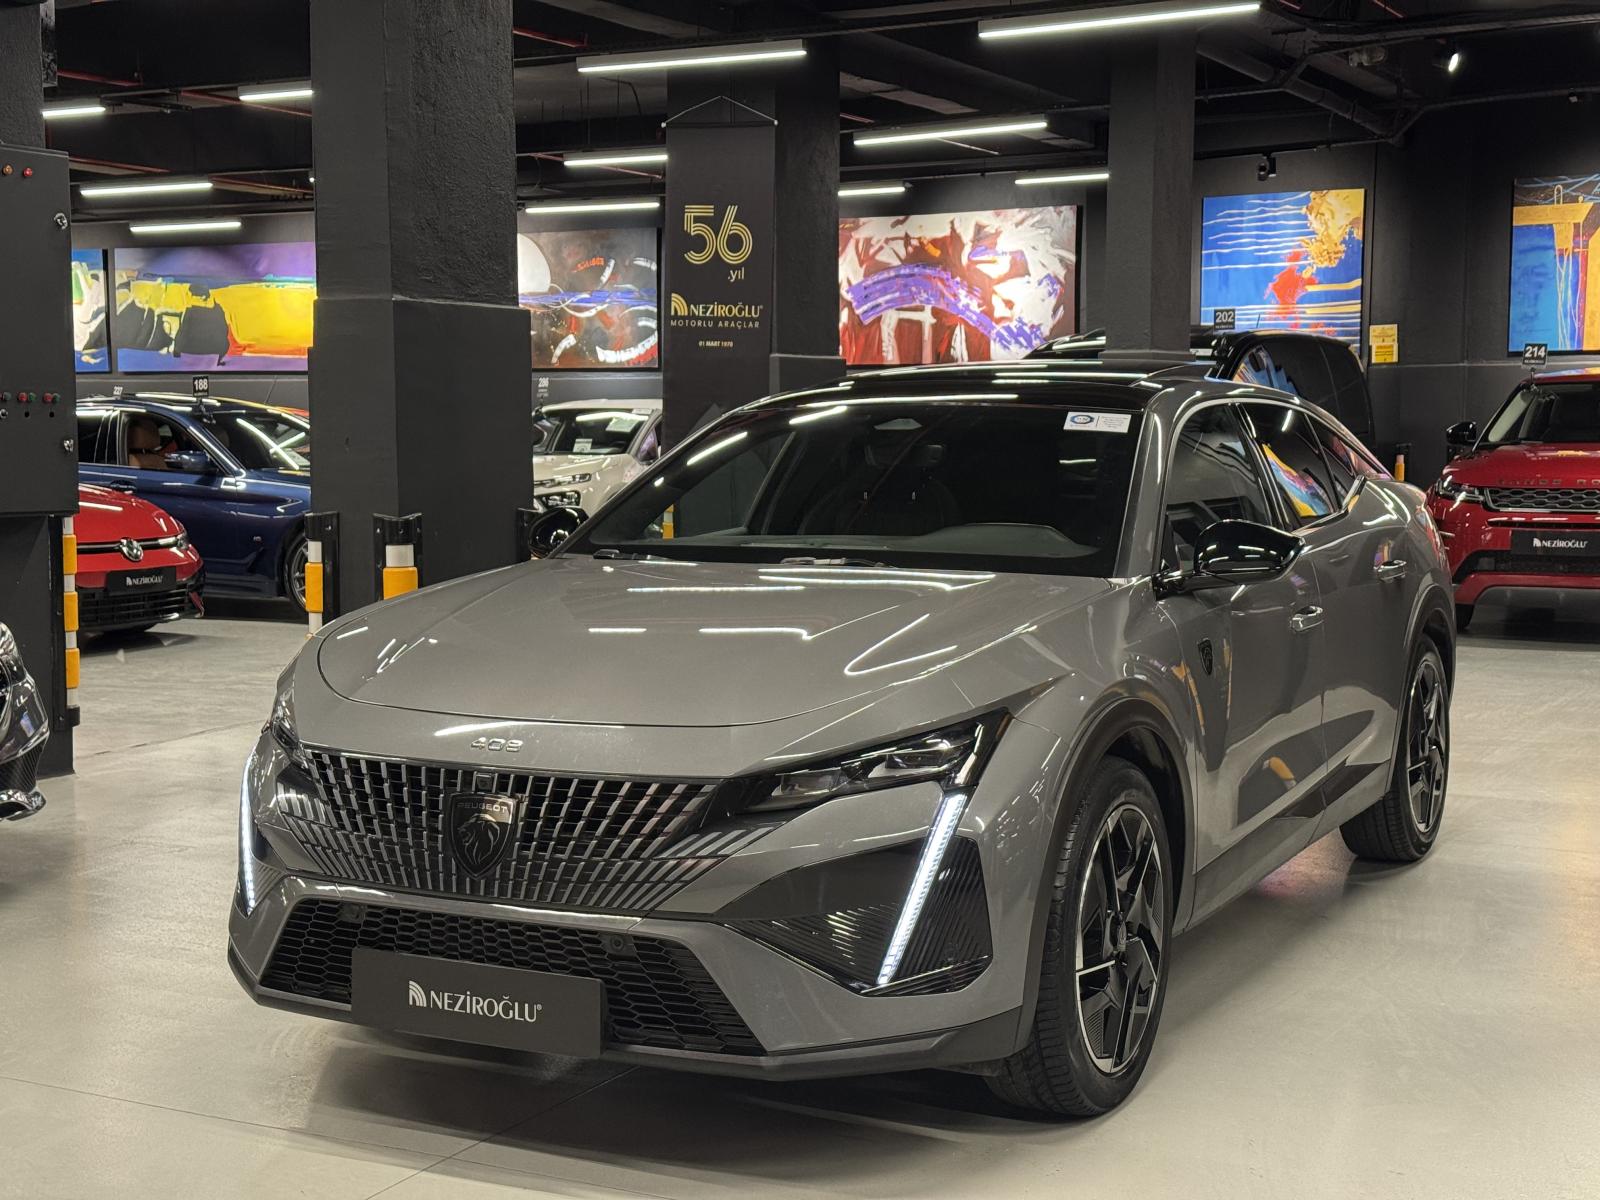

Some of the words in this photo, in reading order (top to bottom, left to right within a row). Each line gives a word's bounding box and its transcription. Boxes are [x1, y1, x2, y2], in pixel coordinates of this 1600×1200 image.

[684, 204, 753, 265] 56
[1215, 311, 1234, 323] 202
[670, 319, 714, 328] MOTORLU
[718, 320, 760, 330] ARAÇLAR
[1524, 345, 1546, 358] 214
[193, 378, 209, 390] 188
[470, 737, 524, 753] 408
[456, 801, 508, 814] PEUGEOT
